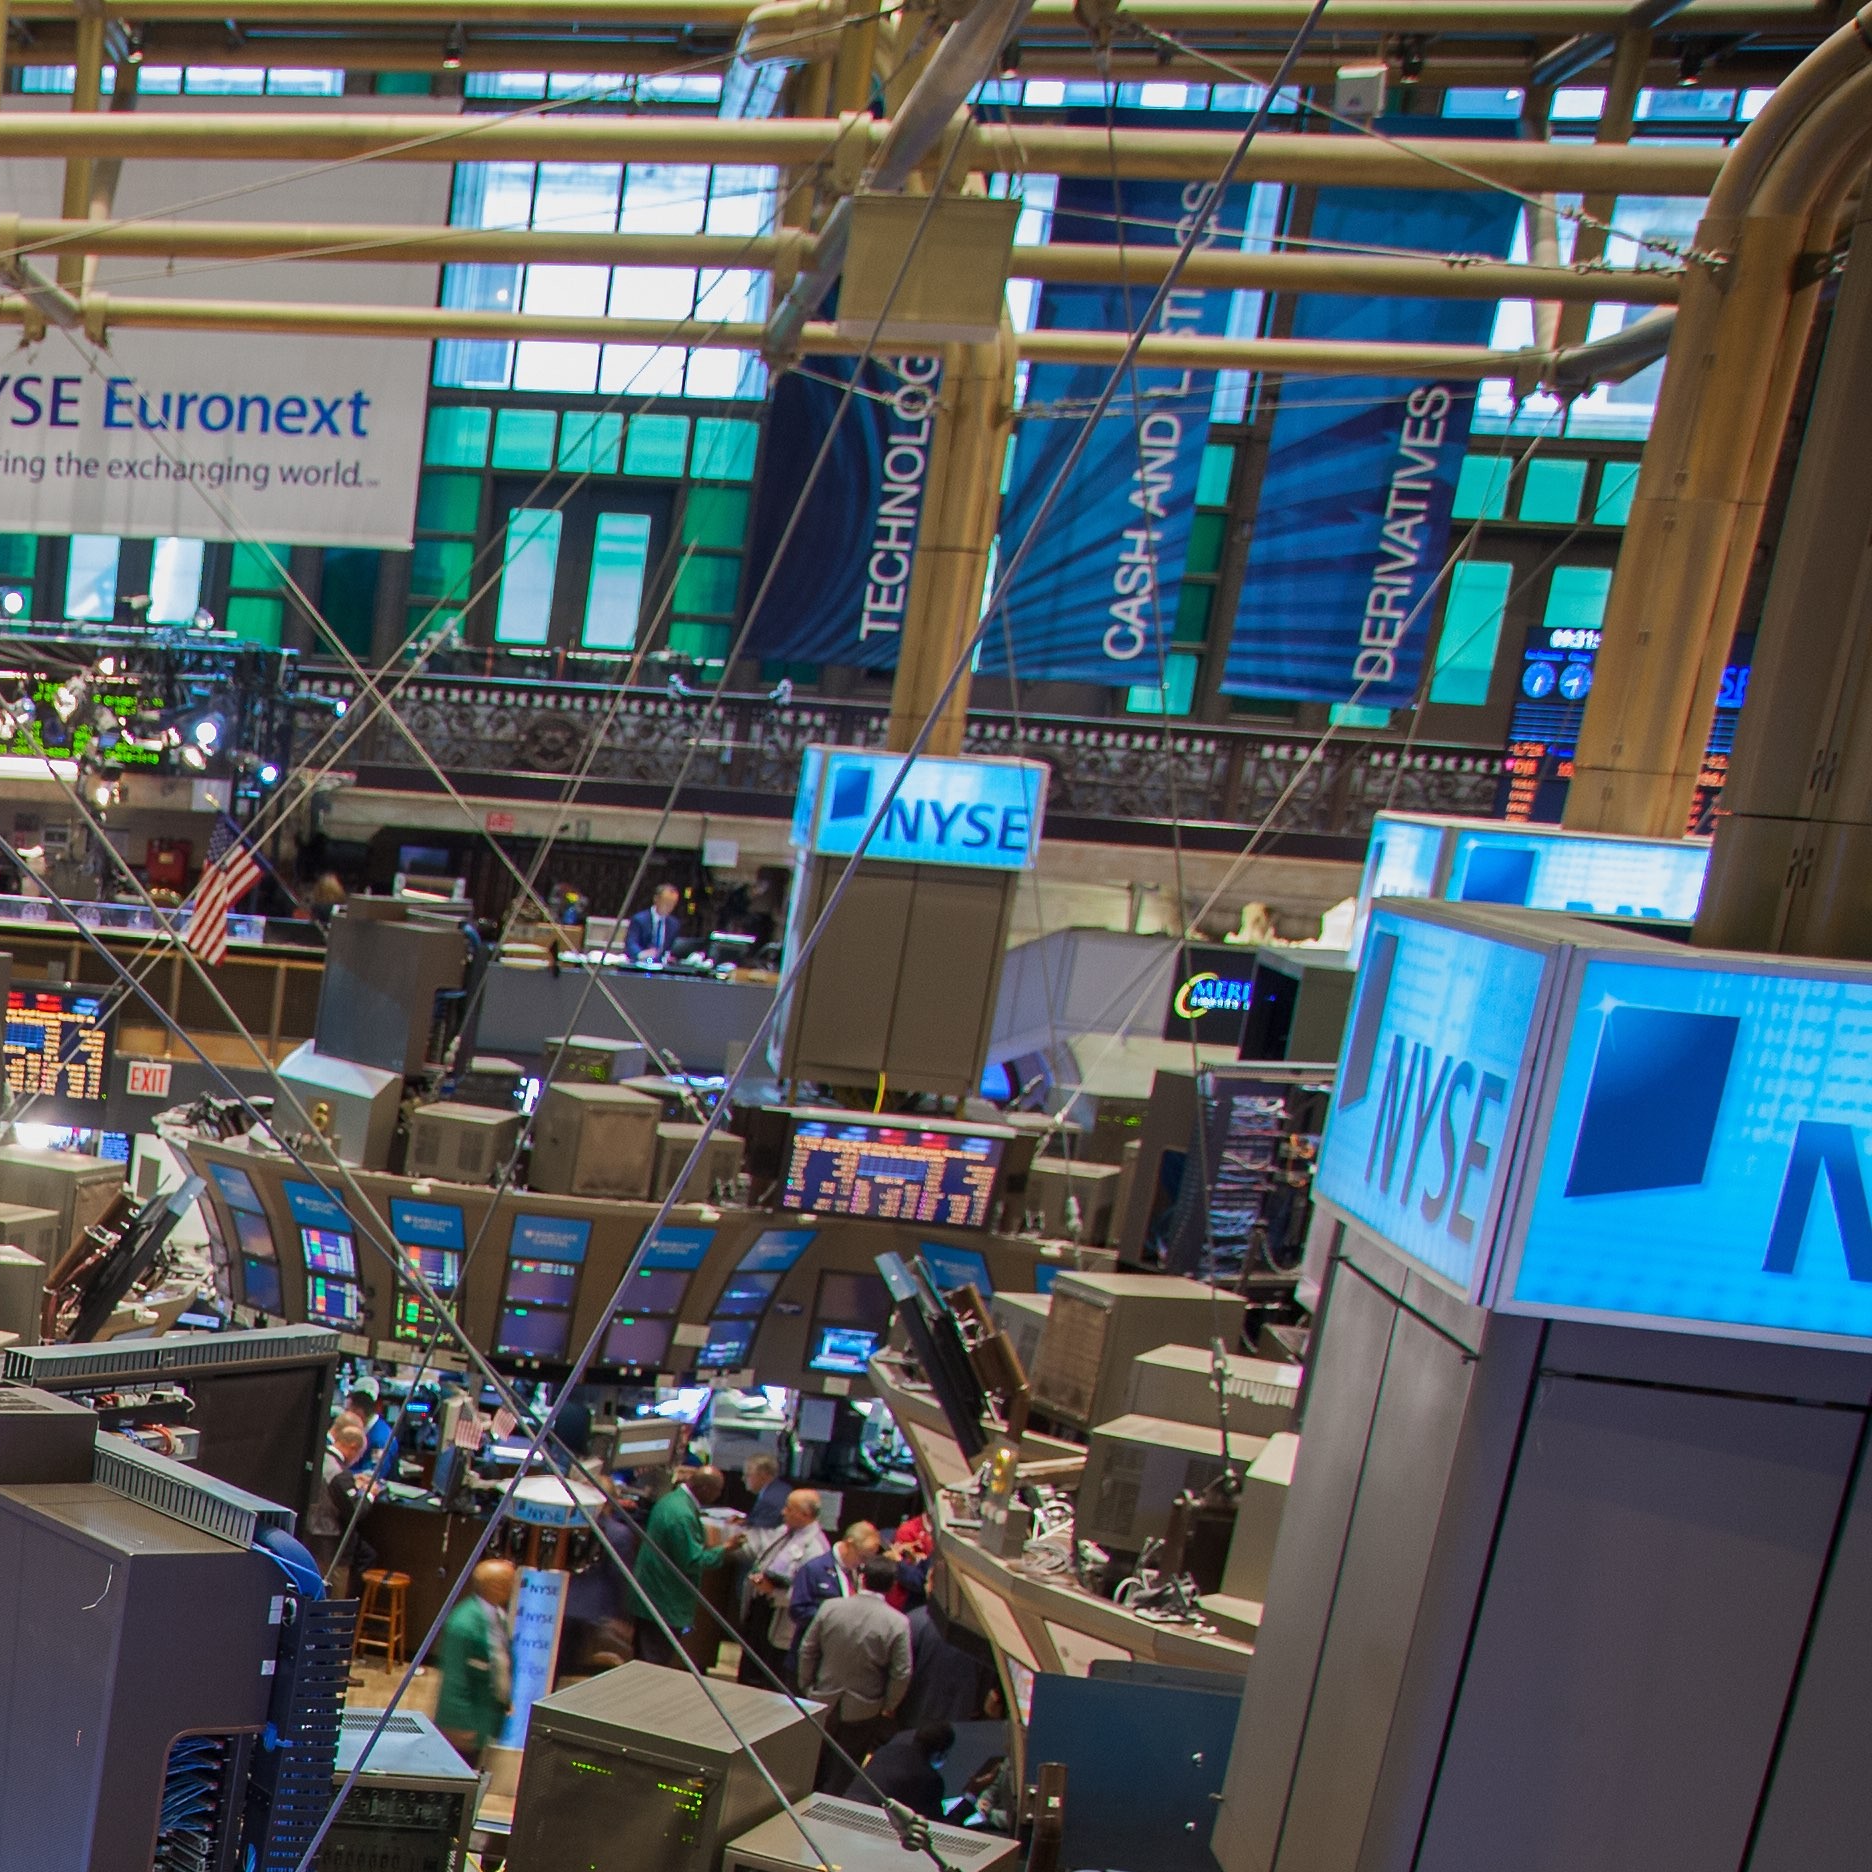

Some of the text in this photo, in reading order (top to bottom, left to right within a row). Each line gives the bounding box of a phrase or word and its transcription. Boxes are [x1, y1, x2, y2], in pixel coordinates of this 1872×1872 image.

[102, 376, 371, 438] Euronext
[54, 450, 100, 480] the
[106, 453, 269, 491] exchanging
[278, 459, 363, 490] world.
[1103, 408, 1184, 661] CASH AND
[1353, 383, 1453, 685] DERIVATIVES
[884, 797, 1031, 854] NYSE
[131, 1066, 168, 1093] EXIT
[1364, 1034, 1508, 1244] NYSE
